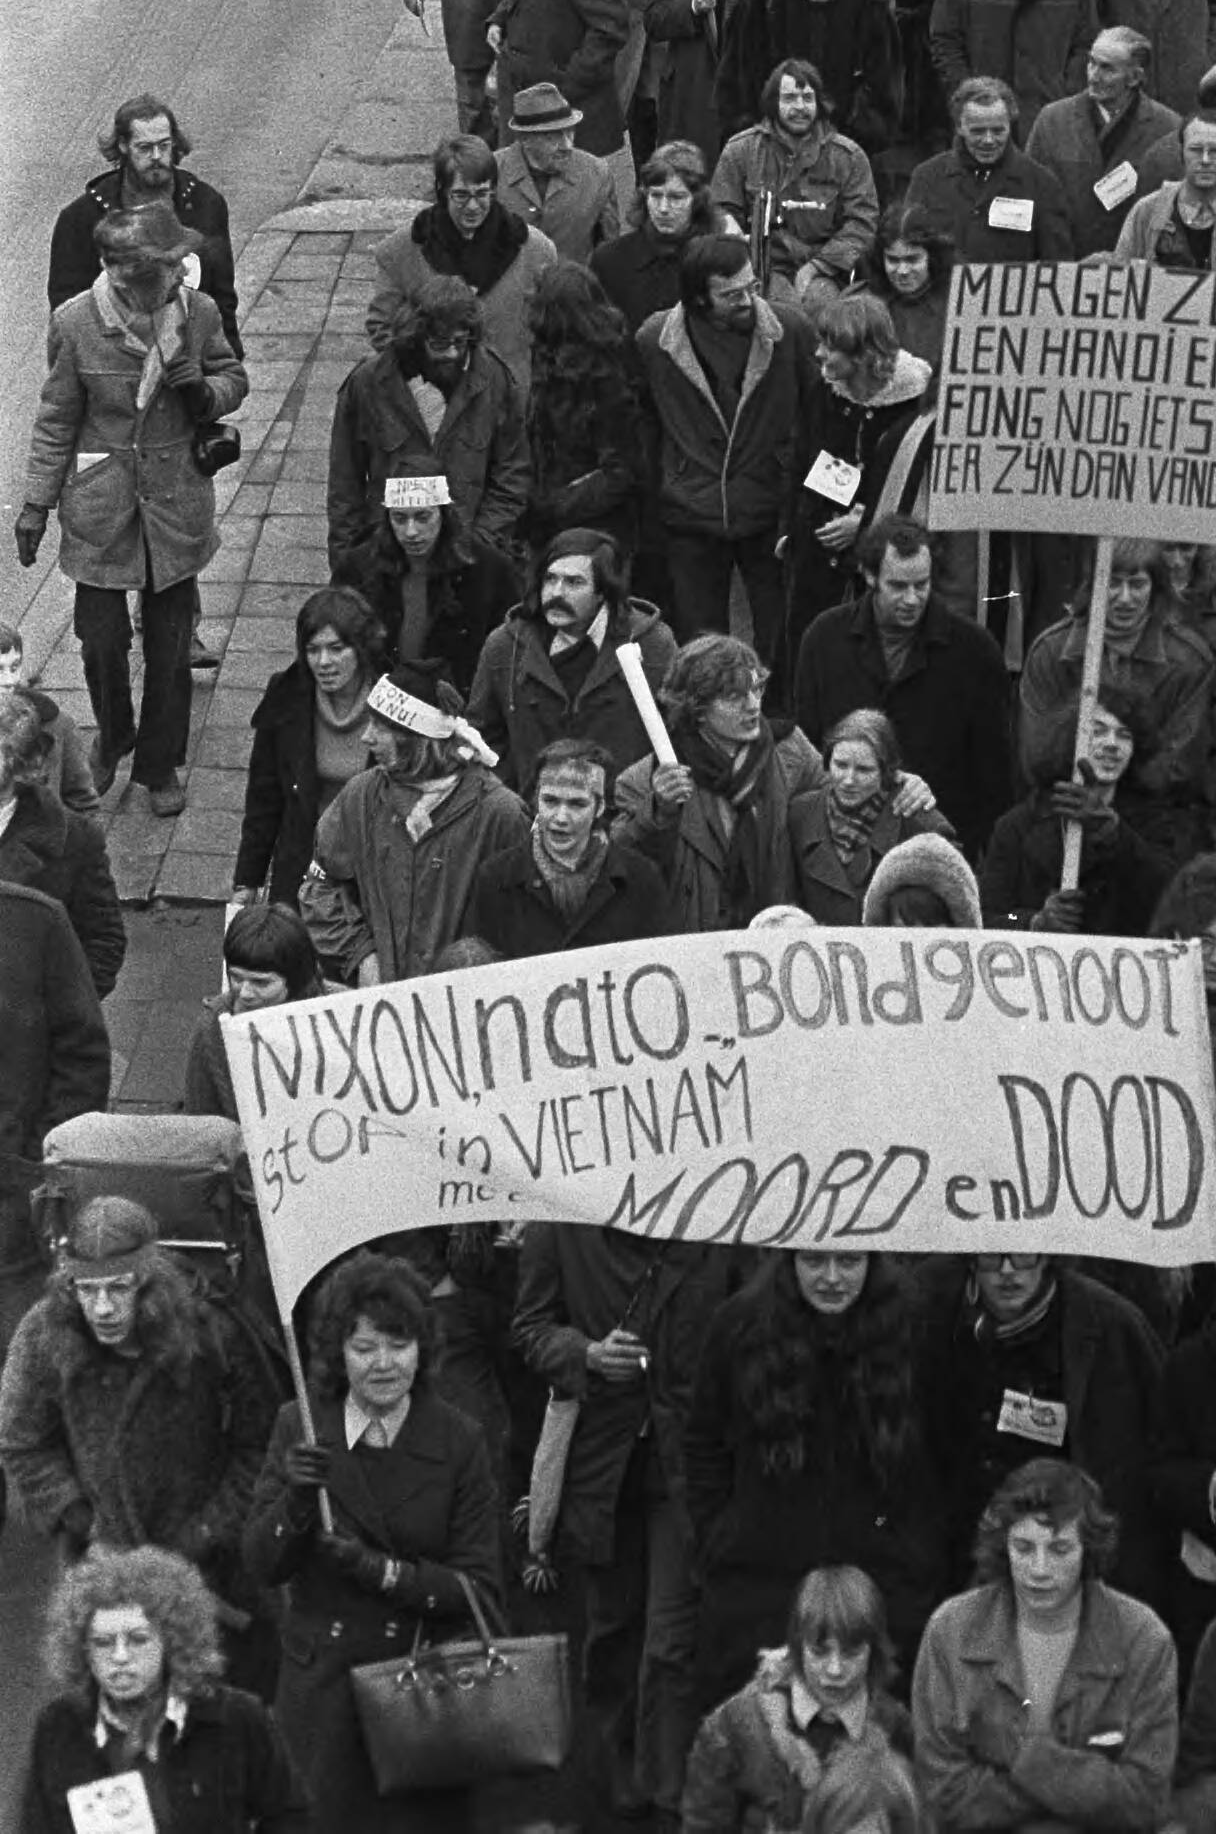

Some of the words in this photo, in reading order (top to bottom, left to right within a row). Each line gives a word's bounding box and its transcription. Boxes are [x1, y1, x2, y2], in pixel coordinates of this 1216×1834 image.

[955, 264, 1152, 321] MORGEN
[949, 326, 1028, 376] LEN
[941, 383, 1046, 440] FONG
[1054, 388, 1132, 447] NOG
[932, 442, 981, 495] TER
[1070, 449, 1137, 503] DAN
[437, 1126, 492, 1175] in
[499, 1055, 753, 1181] VIETNAM
[605, 1145, 930, 1246] MOORD
[945, 1174, 1022, 1223] en
[997, 1071, 1205, 1230] DOOD
